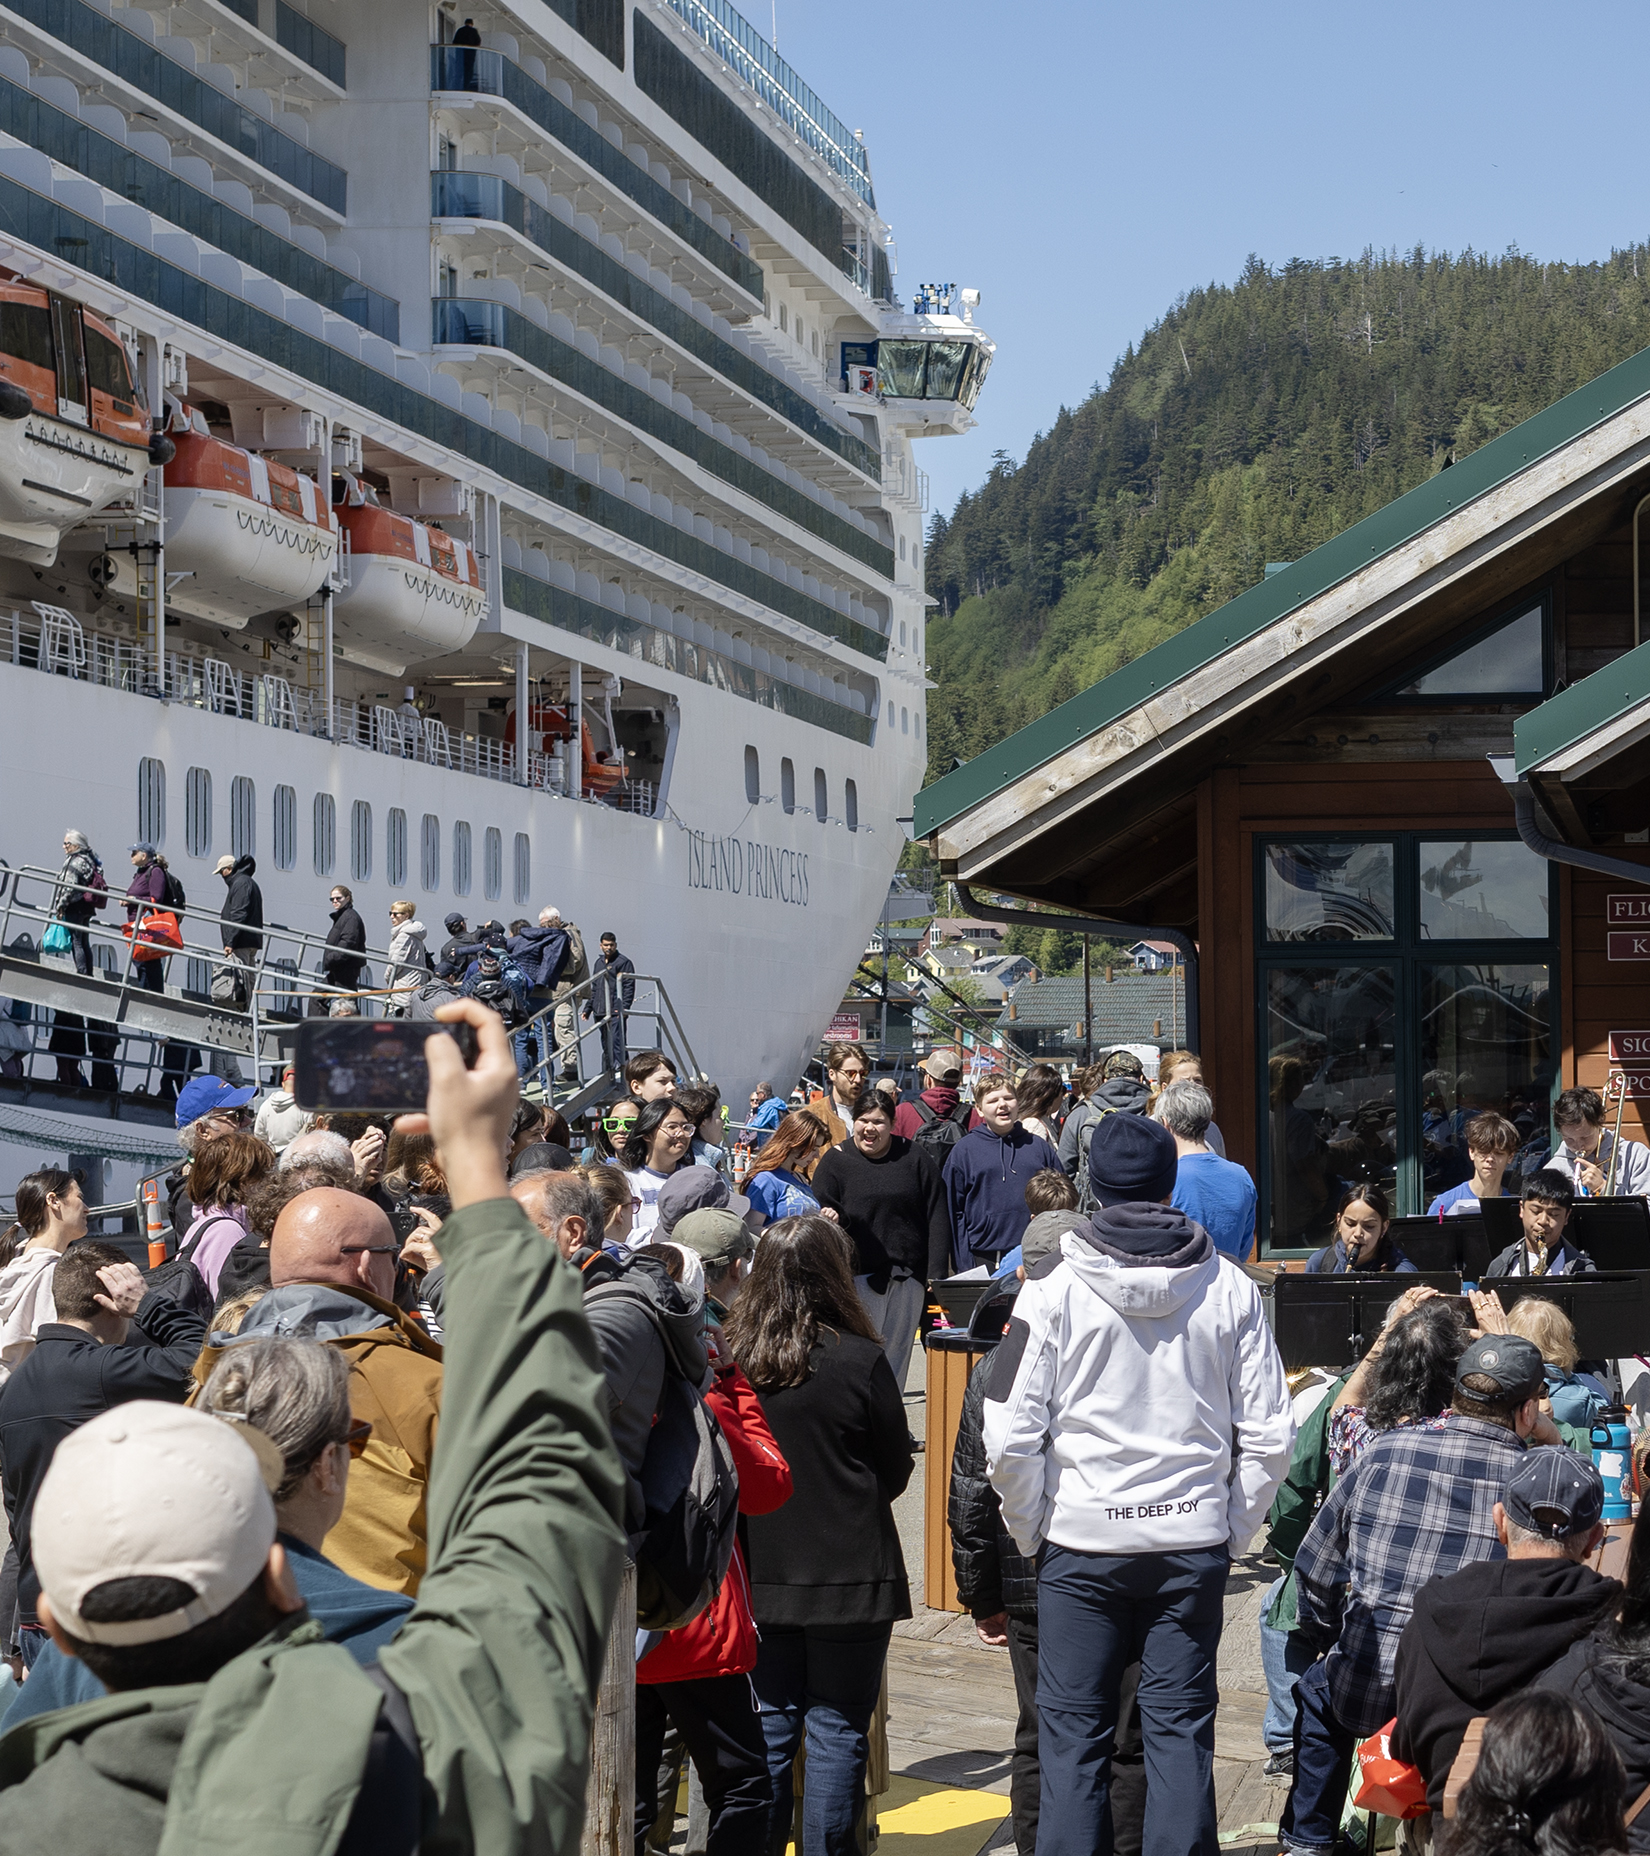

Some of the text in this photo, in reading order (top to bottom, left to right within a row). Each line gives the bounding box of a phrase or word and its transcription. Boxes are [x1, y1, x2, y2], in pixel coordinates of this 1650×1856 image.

[688, 829, 809, 907] ISLAND PRINCESS
[1105, 1500, 1199, 1520] THE DEEP JOY
